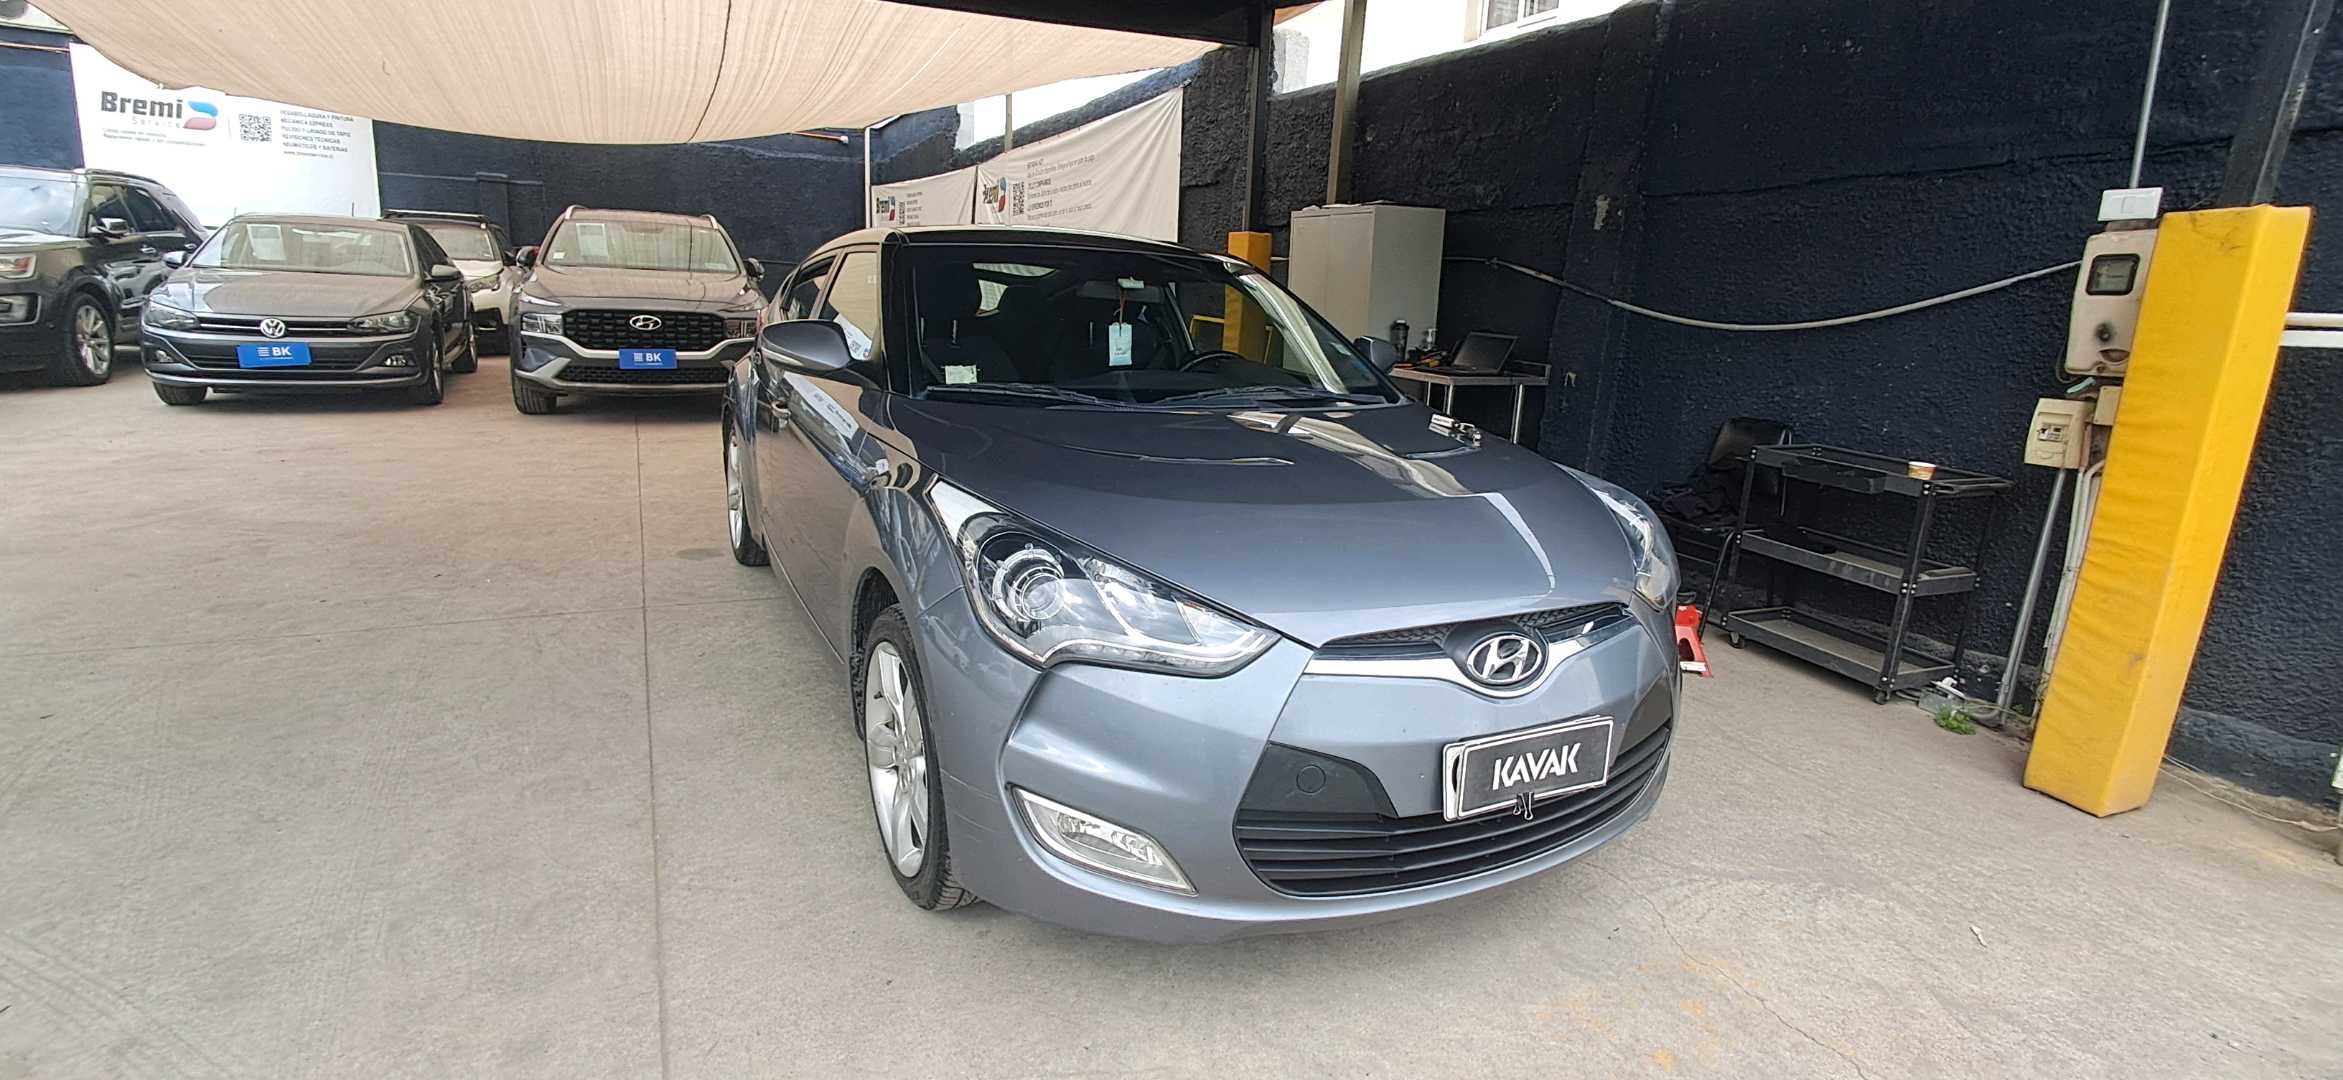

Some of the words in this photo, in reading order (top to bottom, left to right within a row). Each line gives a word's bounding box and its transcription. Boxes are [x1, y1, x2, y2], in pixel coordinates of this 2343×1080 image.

[101, 91, 183, 119] Bremi
[271, 346, 292, 356] BK
[645, 352, 662, 362] BK
[1492, 742, 1582, 791] KAVAK
